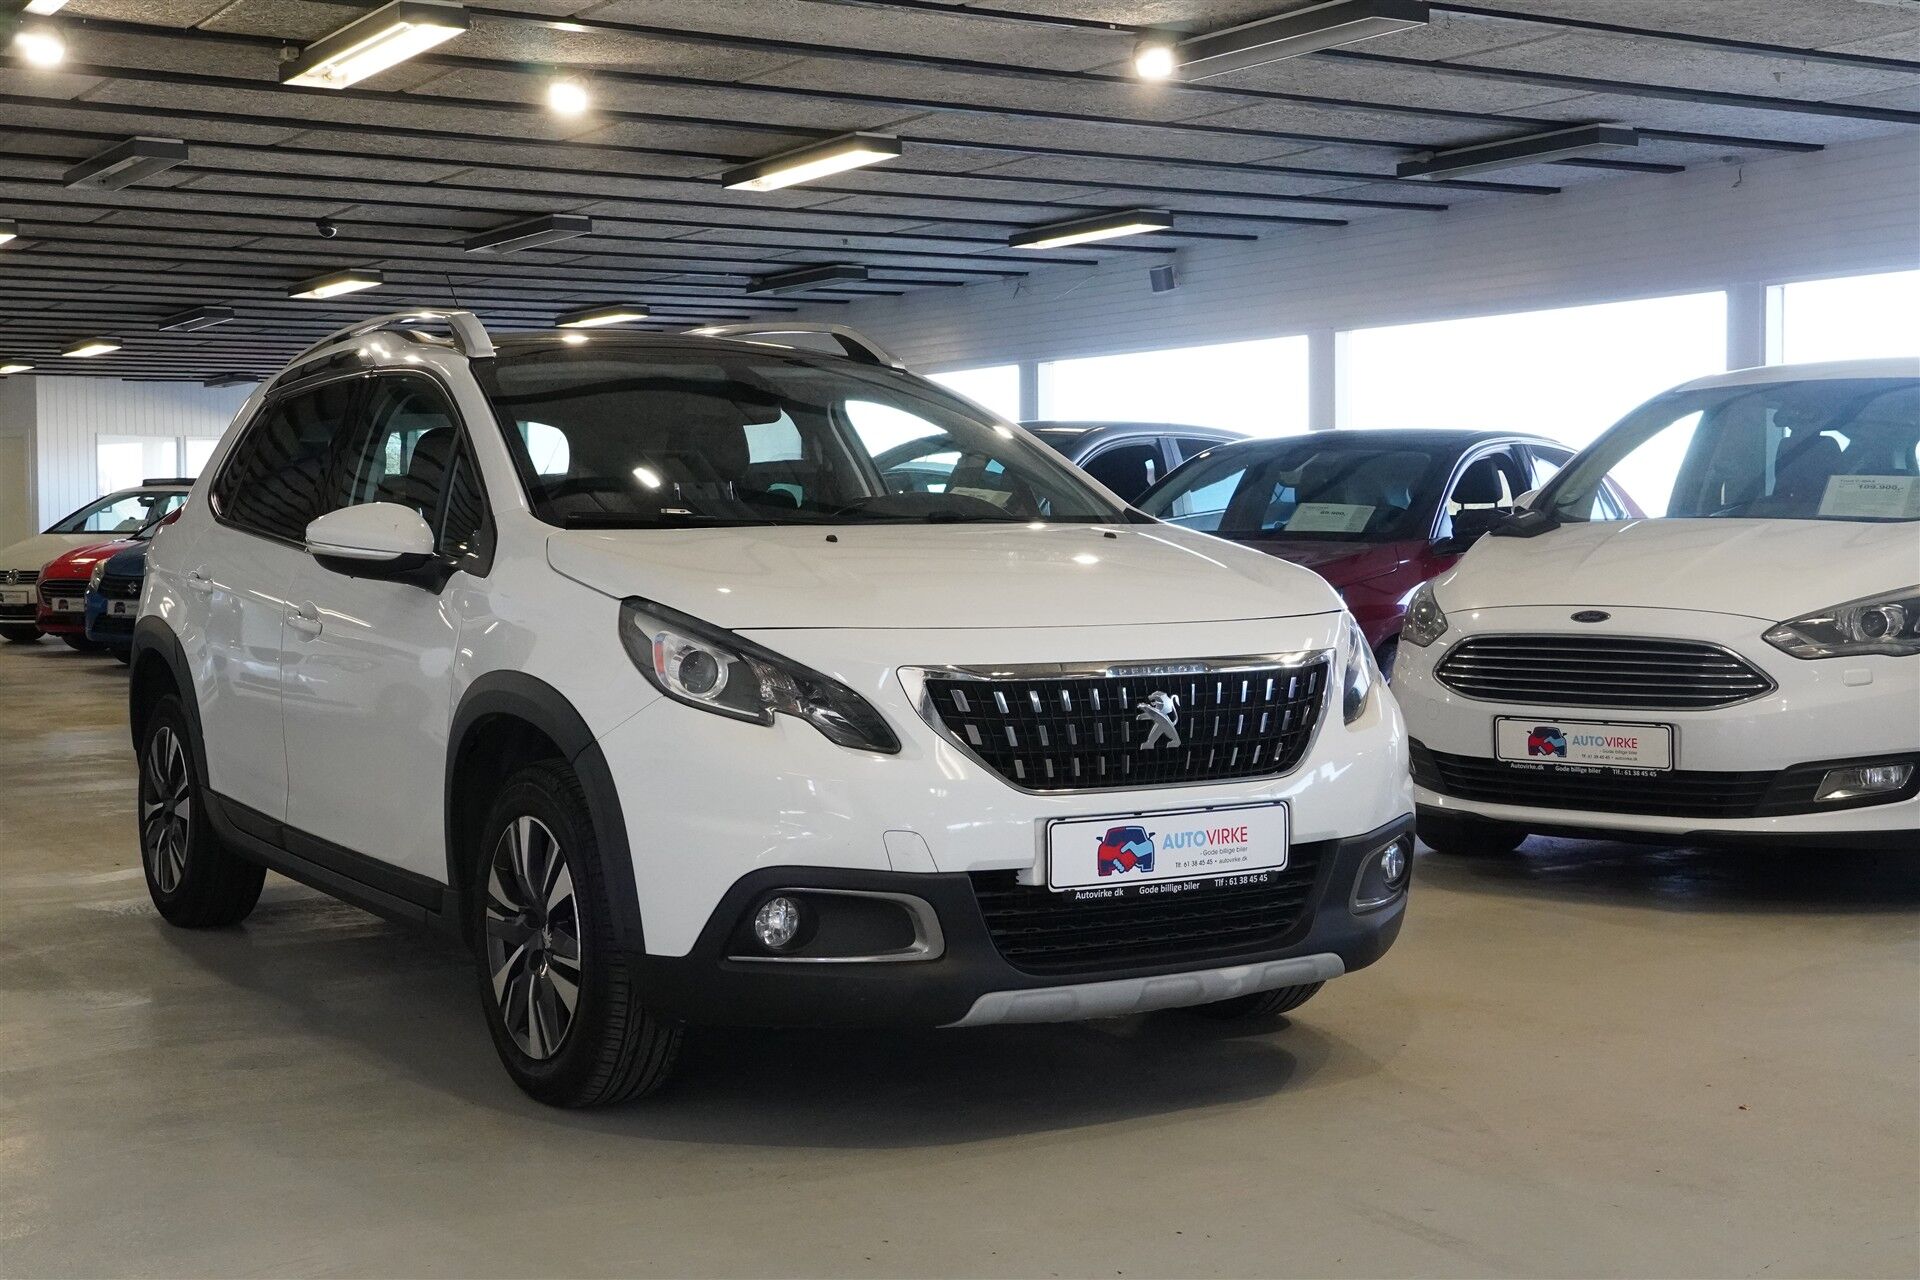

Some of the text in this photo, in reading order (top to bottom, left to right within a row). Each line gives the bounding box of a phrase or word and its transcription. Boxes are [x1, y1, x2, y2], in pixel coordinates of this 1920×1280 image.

[1572, 735, 1638, 749] AUTOVIRKE
[1571, 766, 1587, 774] billige
[1162, 826, 1248, 850] AUTOVIRKE
[1220, 848, 1235, 856] billige
[1139, 885, 1158, 894] Gode
[1160, 883, 1182, 893] billige
[1183, 882, 1200, 890] biler
[1229, 877, 1237, 885] 61
[1239, 876, 1248, 884] 38
[1249, 875, 1258, 883] 45
[1259, 874, 1268, 882] 45
